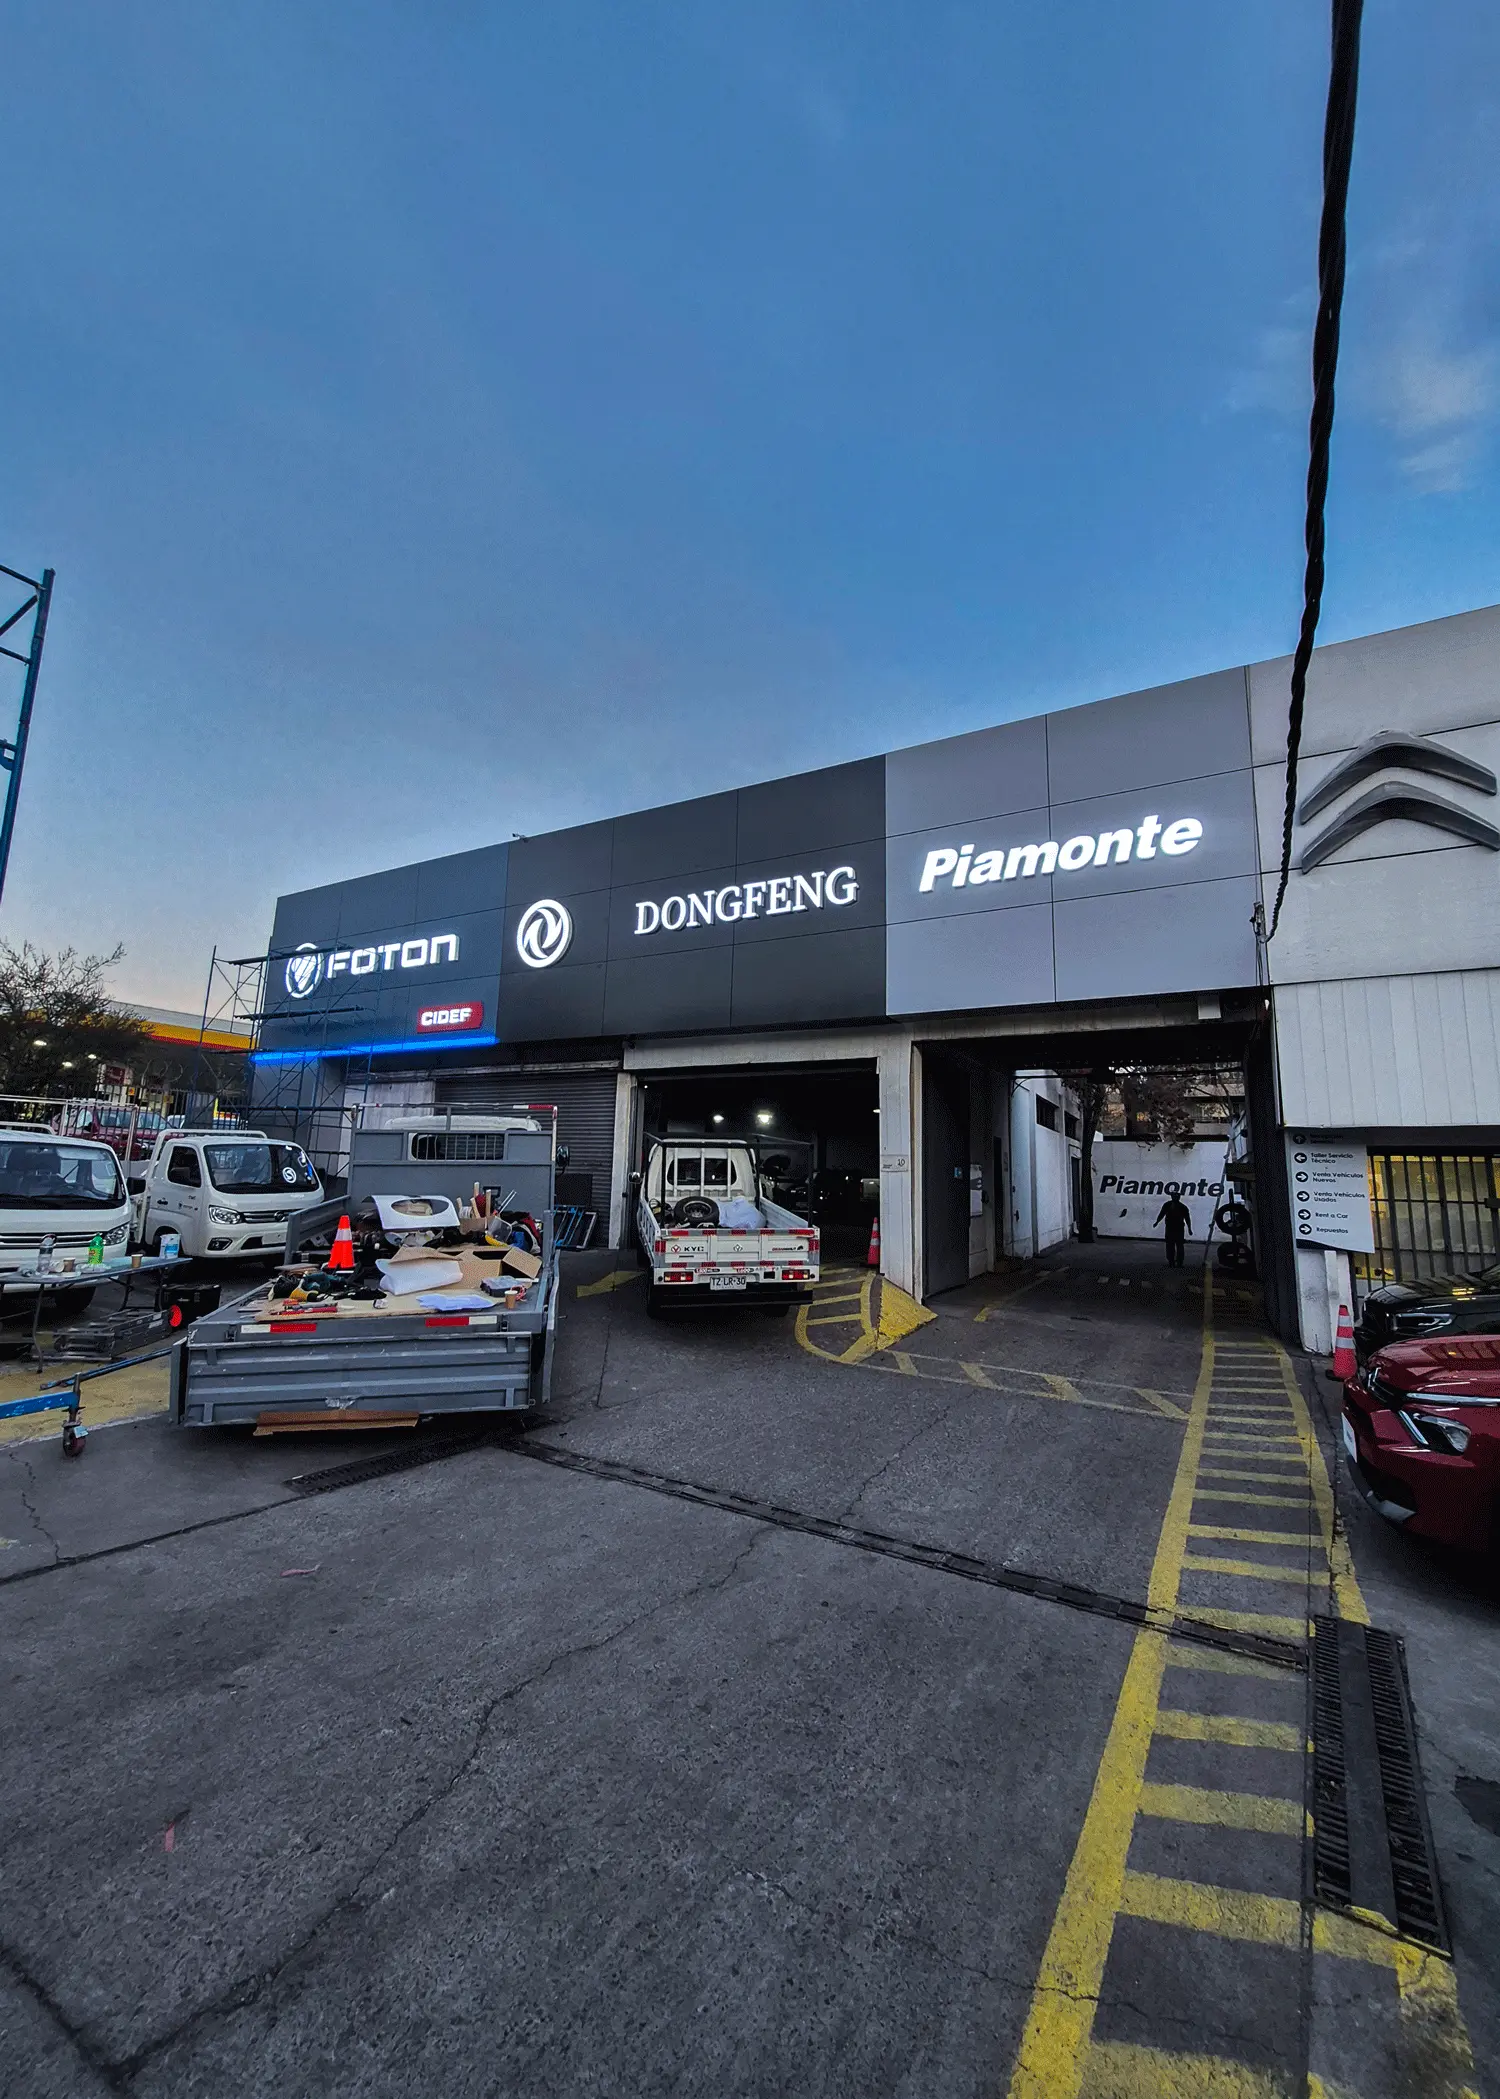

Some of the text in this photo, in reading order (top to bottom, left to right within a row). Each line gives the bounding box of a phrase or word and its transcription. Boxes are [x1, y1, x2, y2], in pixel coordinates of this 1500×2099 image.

[919, 814, 1204, 893] Piamonte
[633, 866, 859, 936] DONGFENG
[327, 933, 460, 979] FOTON
[420, 1007, 473, 1027] CIDEF
[1099, 1175, 1225, 1197] Piamonte
